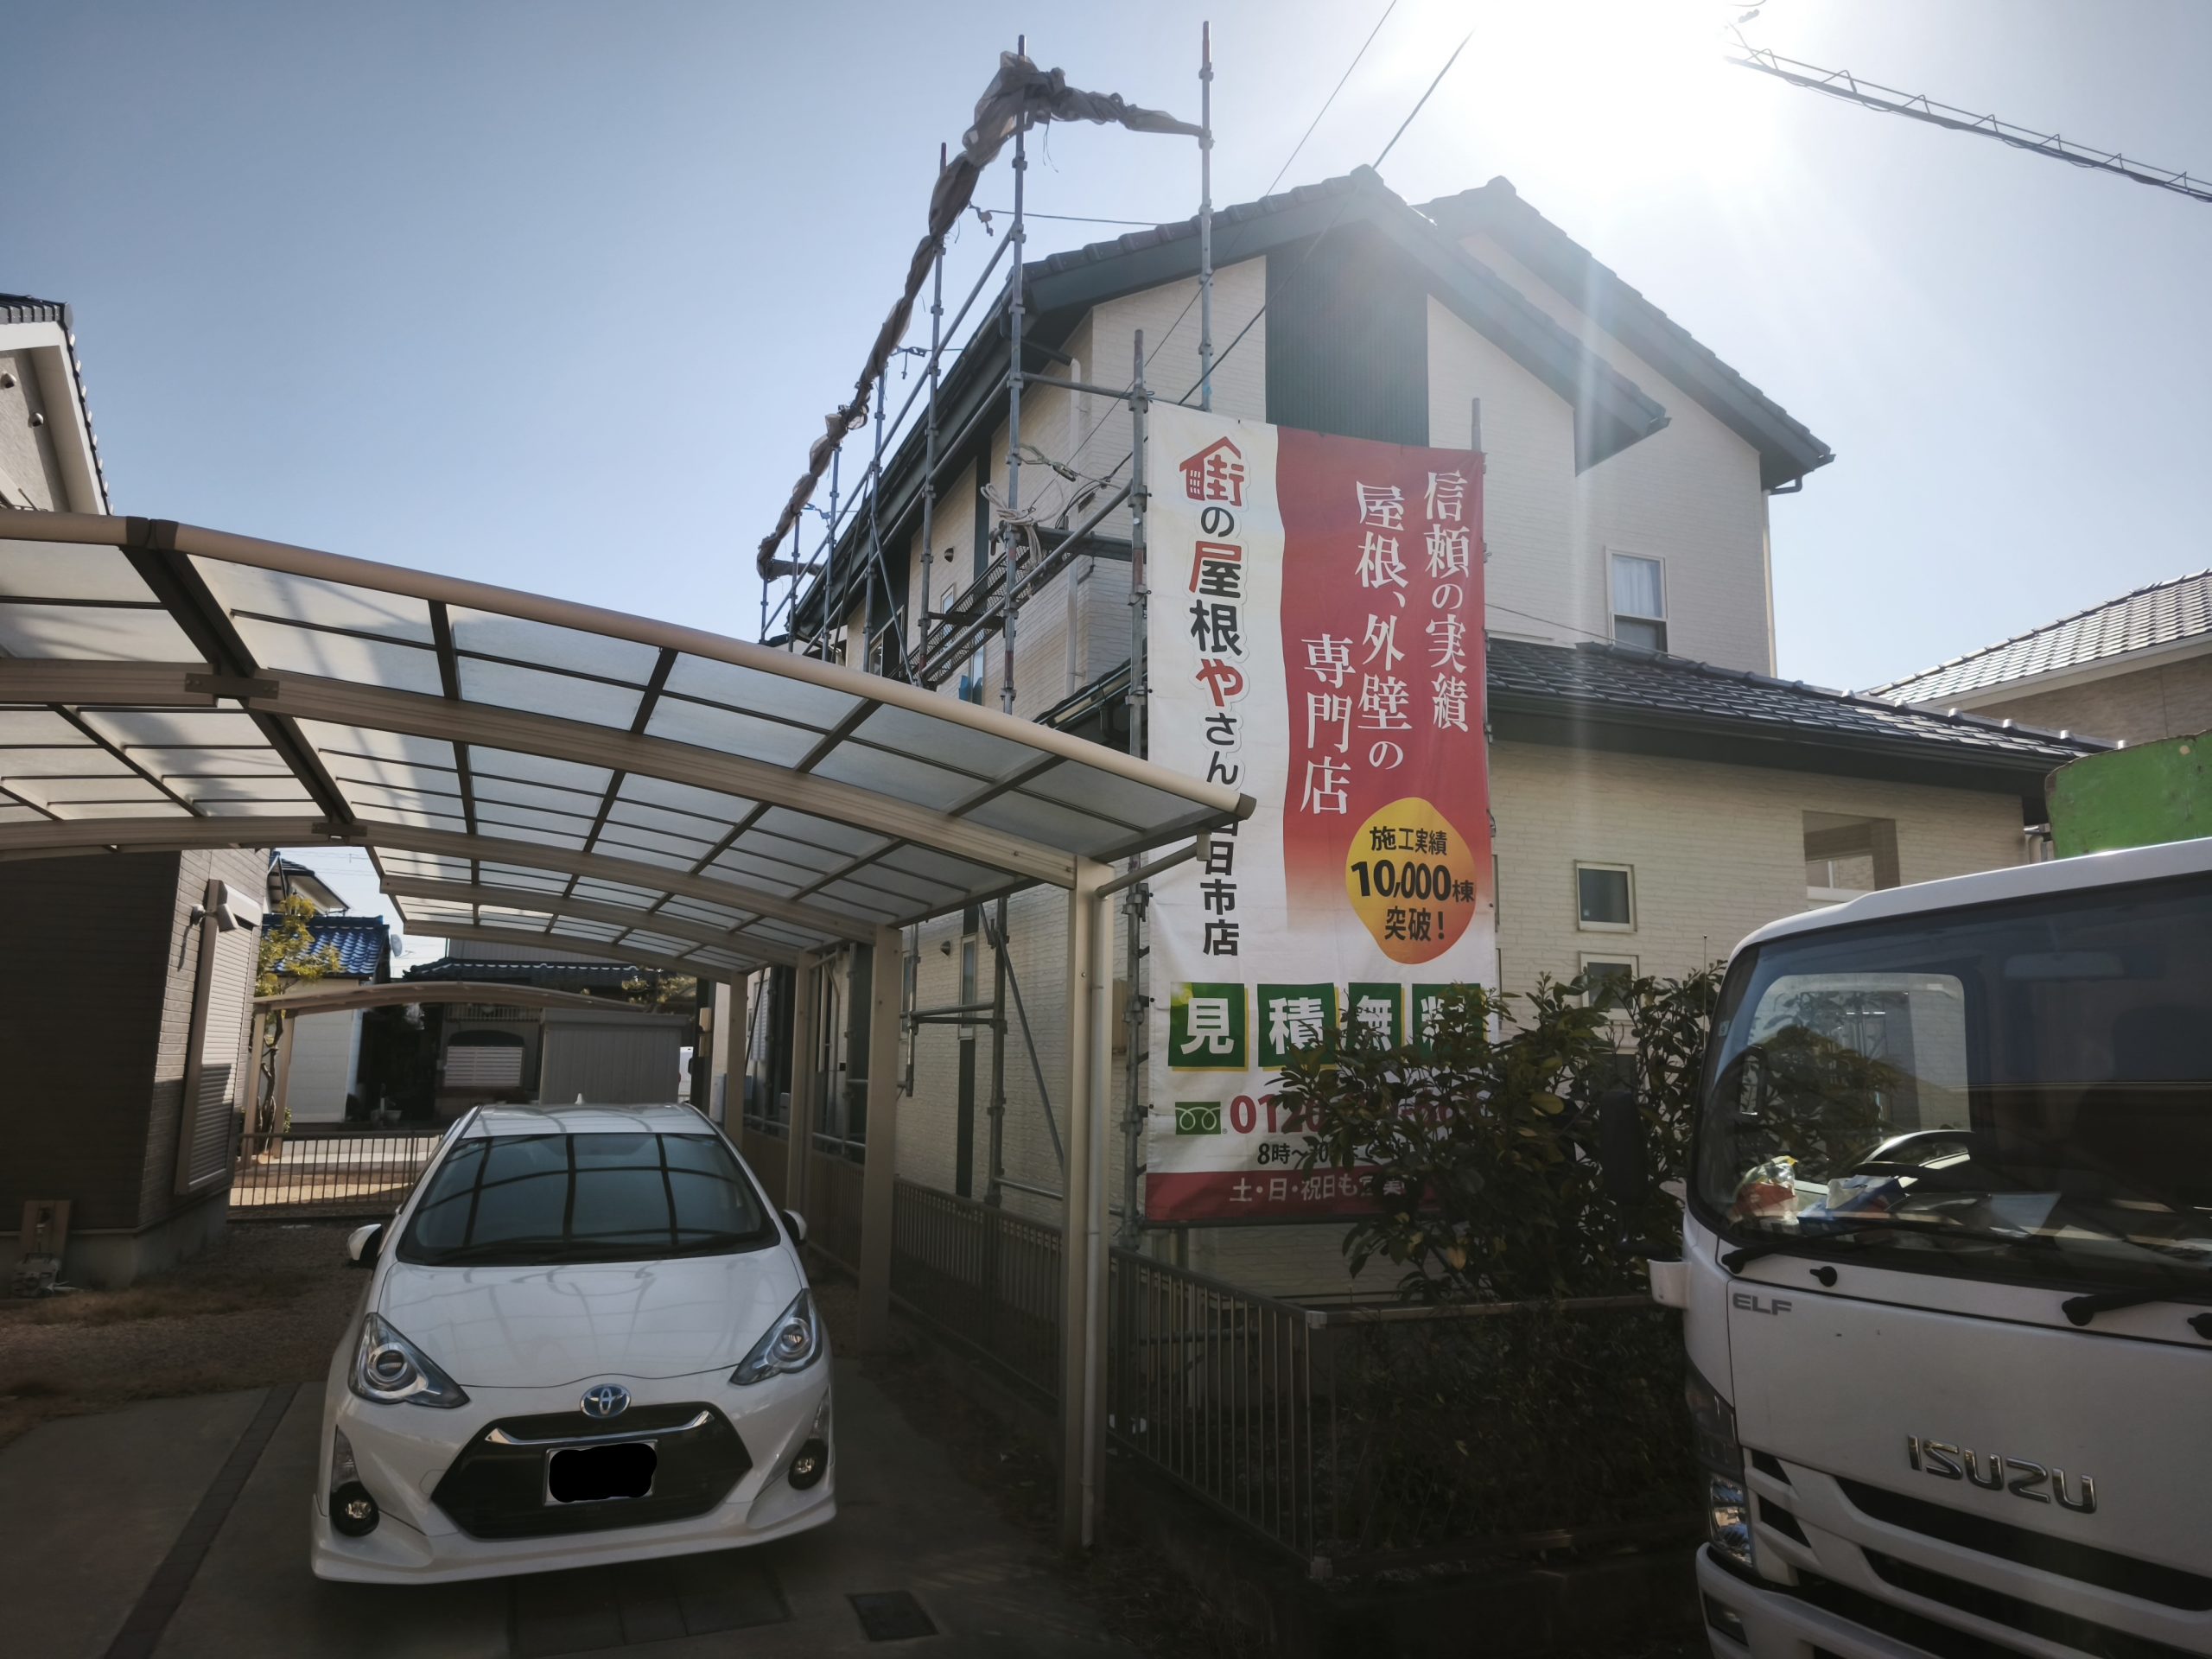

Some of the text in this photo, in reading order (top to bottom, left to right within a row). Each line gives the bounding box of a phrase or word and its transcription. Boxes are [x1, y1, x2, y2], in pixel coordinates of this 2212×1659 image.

[1179, 435, 1245, 785] 街の屋根やさん
[1354, 480, 1413, 771] 屋根、外壁の
[1424, 469, 1471, 733] 信頼の実績
[1300, 633, 1356, 815] 専門店
[1199, 822, 1239, 956] 日市店
[1351, 859, 1475, 902] 10,000棟
[1370, 826, 1447, 855] 施工実績
[1384, 906, 1445, 942] 突破!
[1732, 1293, 1792, 1316] ELF
[1907, 1434, 2097, 1514] ISUZU
